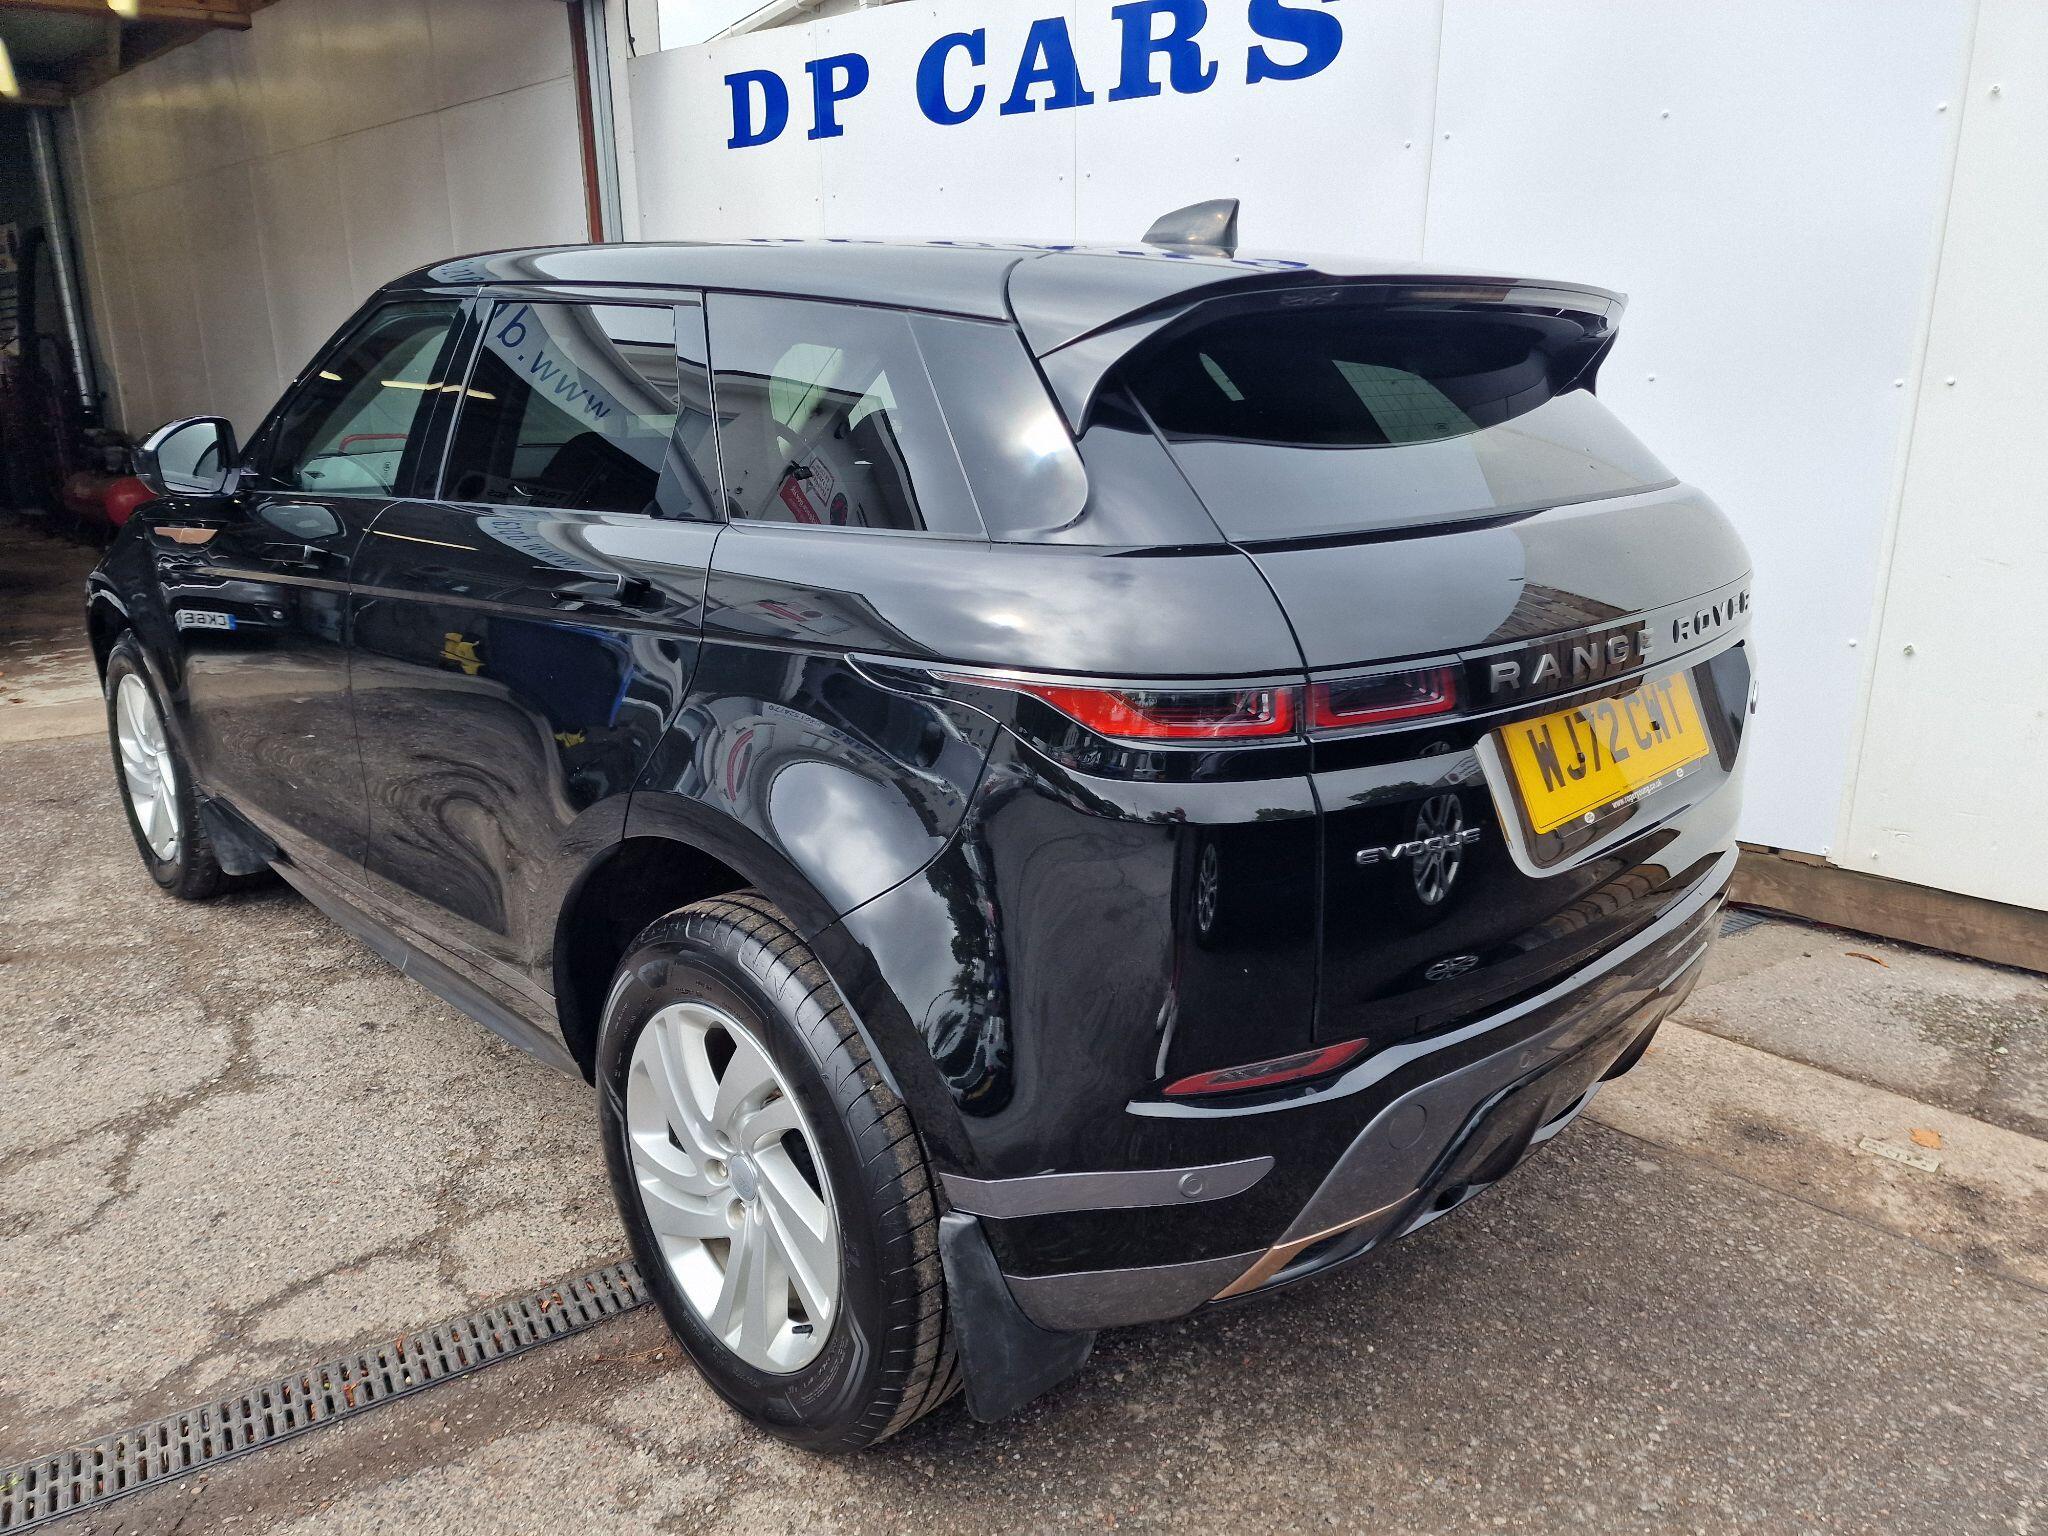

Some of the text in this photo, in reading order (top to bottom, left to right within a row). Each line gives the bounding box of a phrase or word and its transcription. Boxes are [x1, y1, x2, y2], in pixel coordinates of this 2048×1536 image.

[724, 0, 1344, 149] DP CARS
[1489, 589, 1750, 694] RANGE ROVER
[1526, 701, 1630, 793] WJ72
[1356, 827, 1481, 865] EVOQUE
